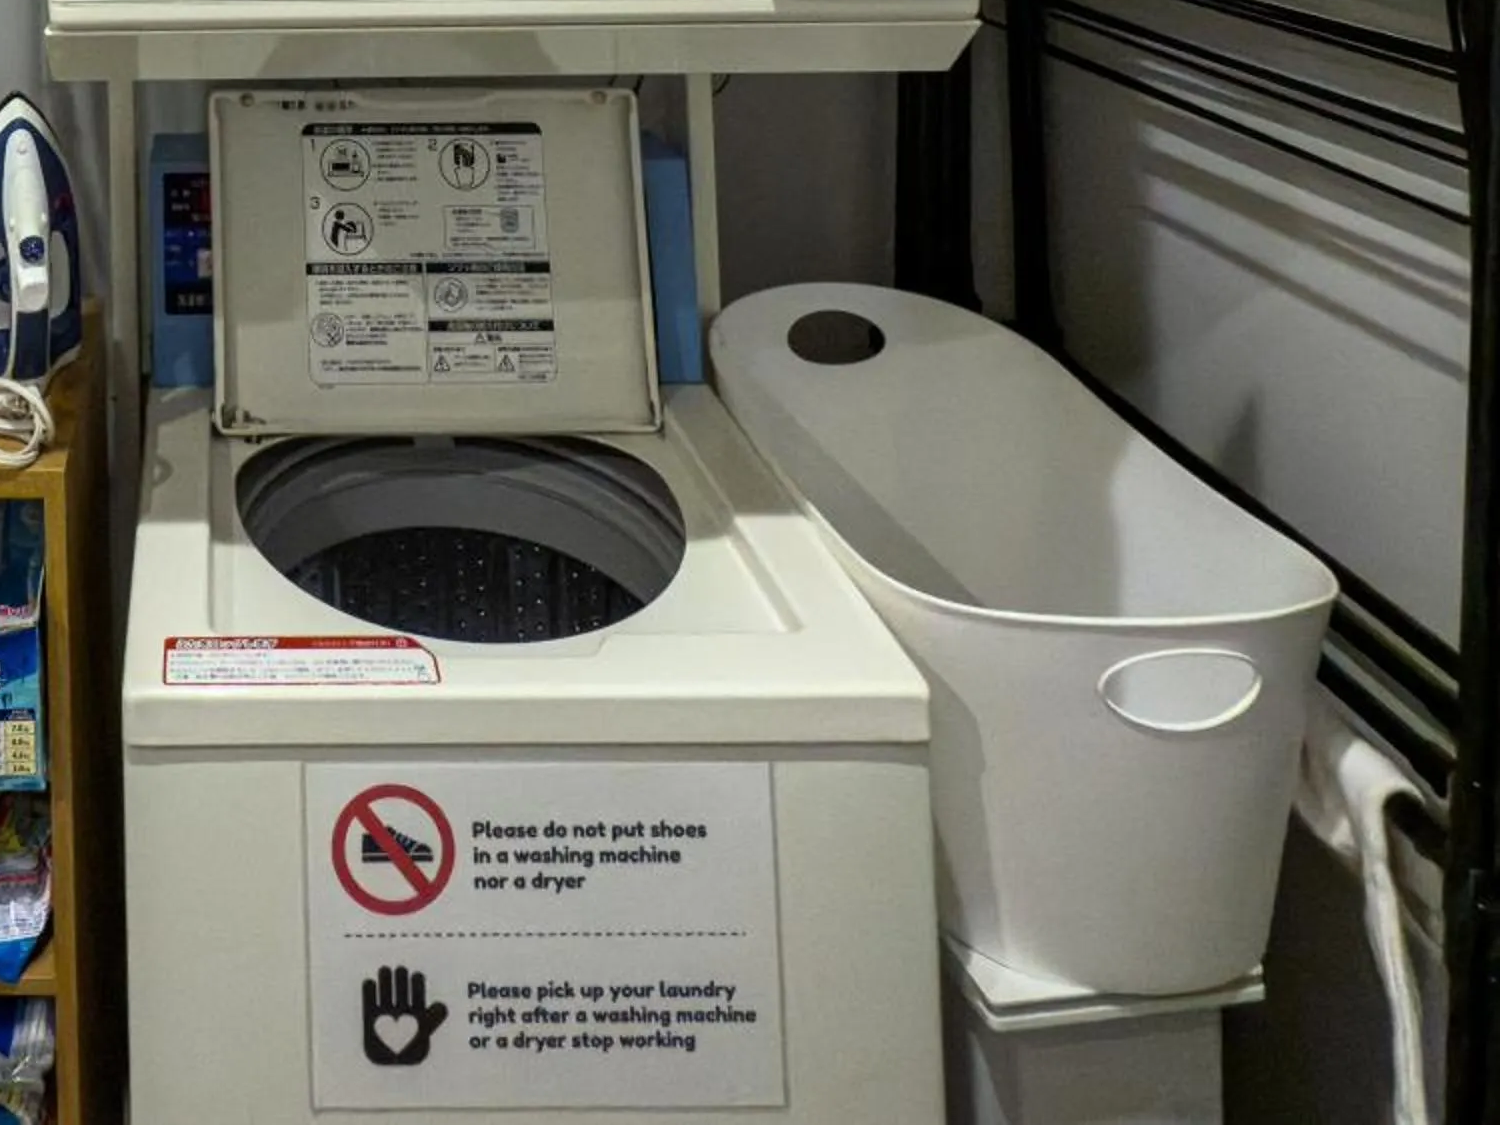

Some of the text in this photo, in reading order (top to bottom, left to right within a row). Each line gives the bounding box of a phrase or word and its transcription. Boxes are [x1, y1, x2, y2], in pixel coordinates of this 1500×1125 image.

[472, 820, 707, 842] Please do not put shoes
[474, 846, 681, 868] in a washing machine
[474, 872, 586, 893] nor a dryer
[468, 981, 736, 1003] Please pick up your laundry
[469, 1005, 756, 1028] right after a washing machine
[469, 1030, 696, 1053] or a dryer stop working
